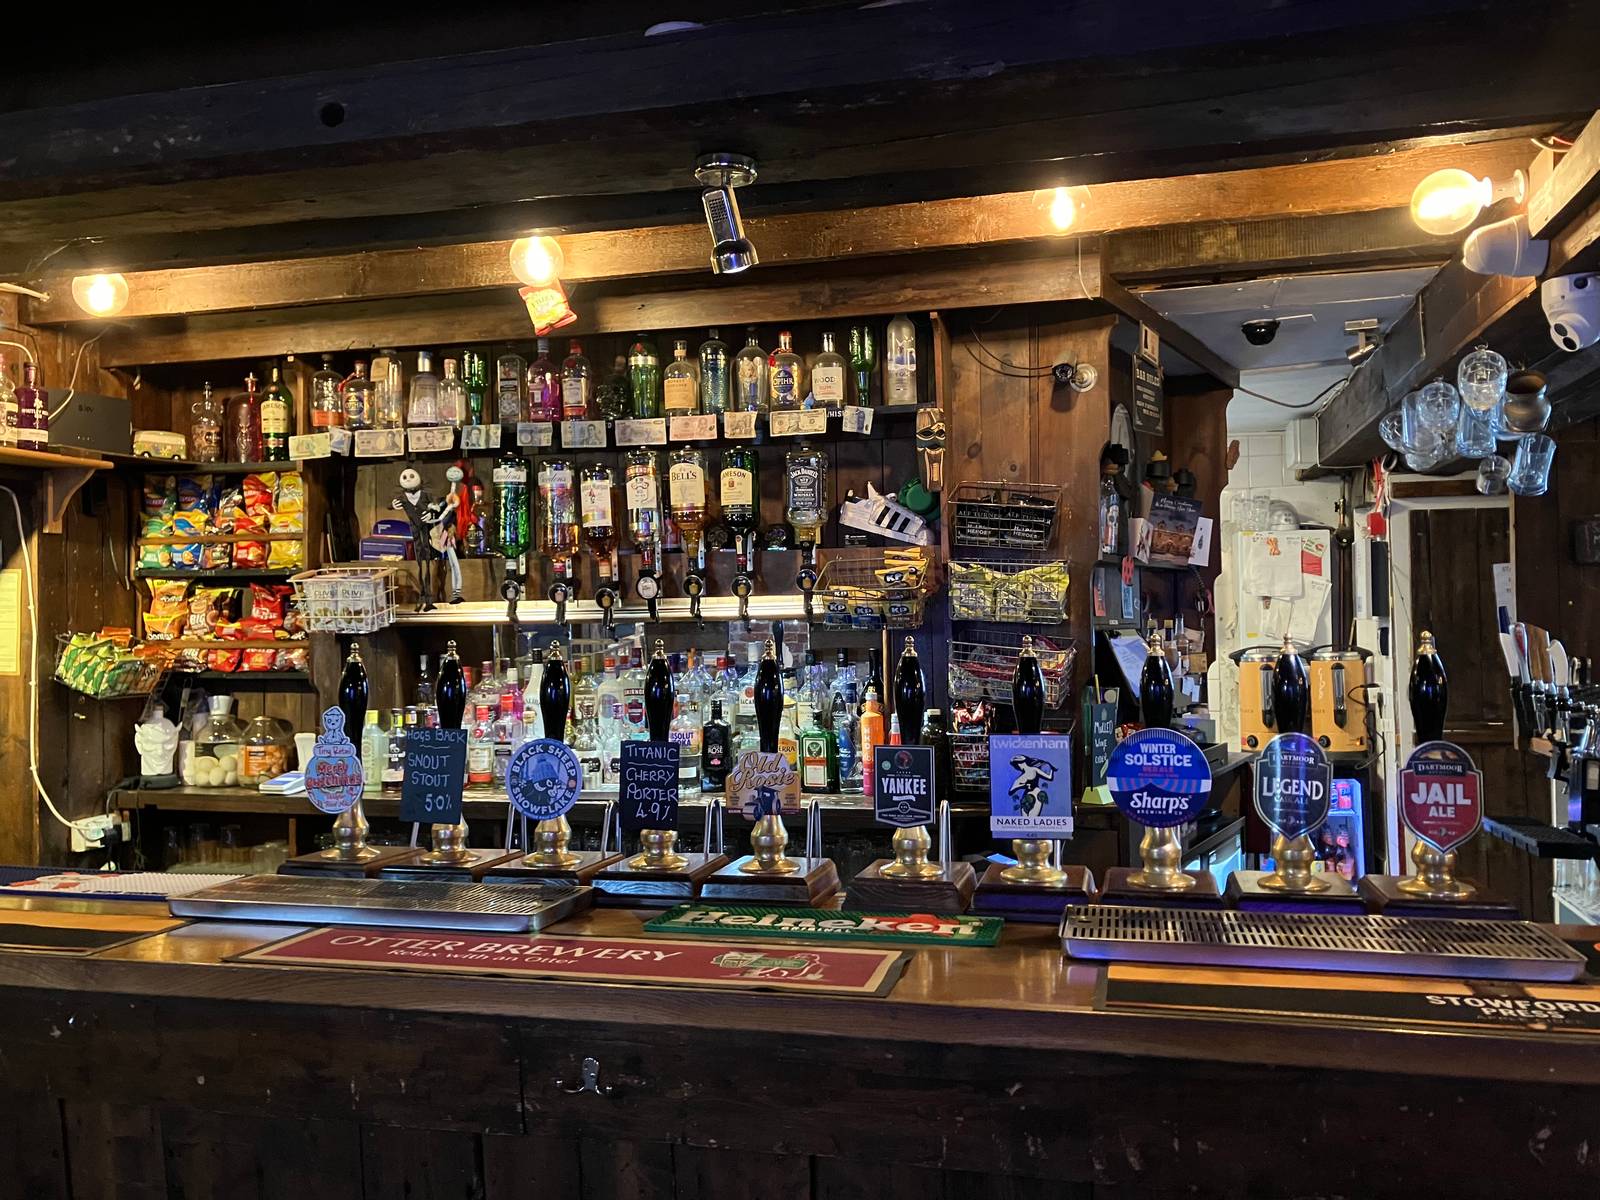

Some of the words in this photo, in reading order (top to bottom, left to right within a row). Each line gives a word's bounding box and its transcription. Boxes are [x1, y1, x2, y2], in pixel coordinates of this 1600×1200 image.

[671, 471, 697, 481] BELL'S
[886, 572, 903, 582] KP
[435, 729, 466, 744] BACK
[992, 737, 1068, 749] twickenham
[625, 744, 679, 762] TITANIC
[1140, 743, 1176, 754] WINTER
[408, 753, 451, 770] SNOUT
[512, 744, 544, 773] BLACK
[548, 745, 576, 777] SHEEP
[740, 751, 783, 773] Old
[1125, 754, 1192, 767] SOLSTICE
[1418, 764, 1463, 773] DARTMOOR
[411, 771, 450, 787] STOUT
[626, 767, 675, 785] CHERRY
[729, 767, 797, 792] Rosie
[626, 782, 678, 802] PORTER
[881, 777, 927, 795] YANKEE
[1262, 777, 1324, 800] LEGEND
[1411, 782, 1472, 805] JAIL
[513, 787, 573, 814] SNOWFLAKE
[1129, 791, 1190, 814] Sharp's
[1429, 806, 1455, 817] ALE
[996, 818, 1030, 826] NAKED
[673, 911, 974, 935] Heineken
[330, 935, 465, 951] OTTER
[468, 943, 682, 962] BREWERY
[387, 949, 437, 957] Relax
[525, 956, 578, 964] Otter
[1426, 995, 1600, 1013] STOWFORD
[1481, 1007, 1565, 1019] PRESS
